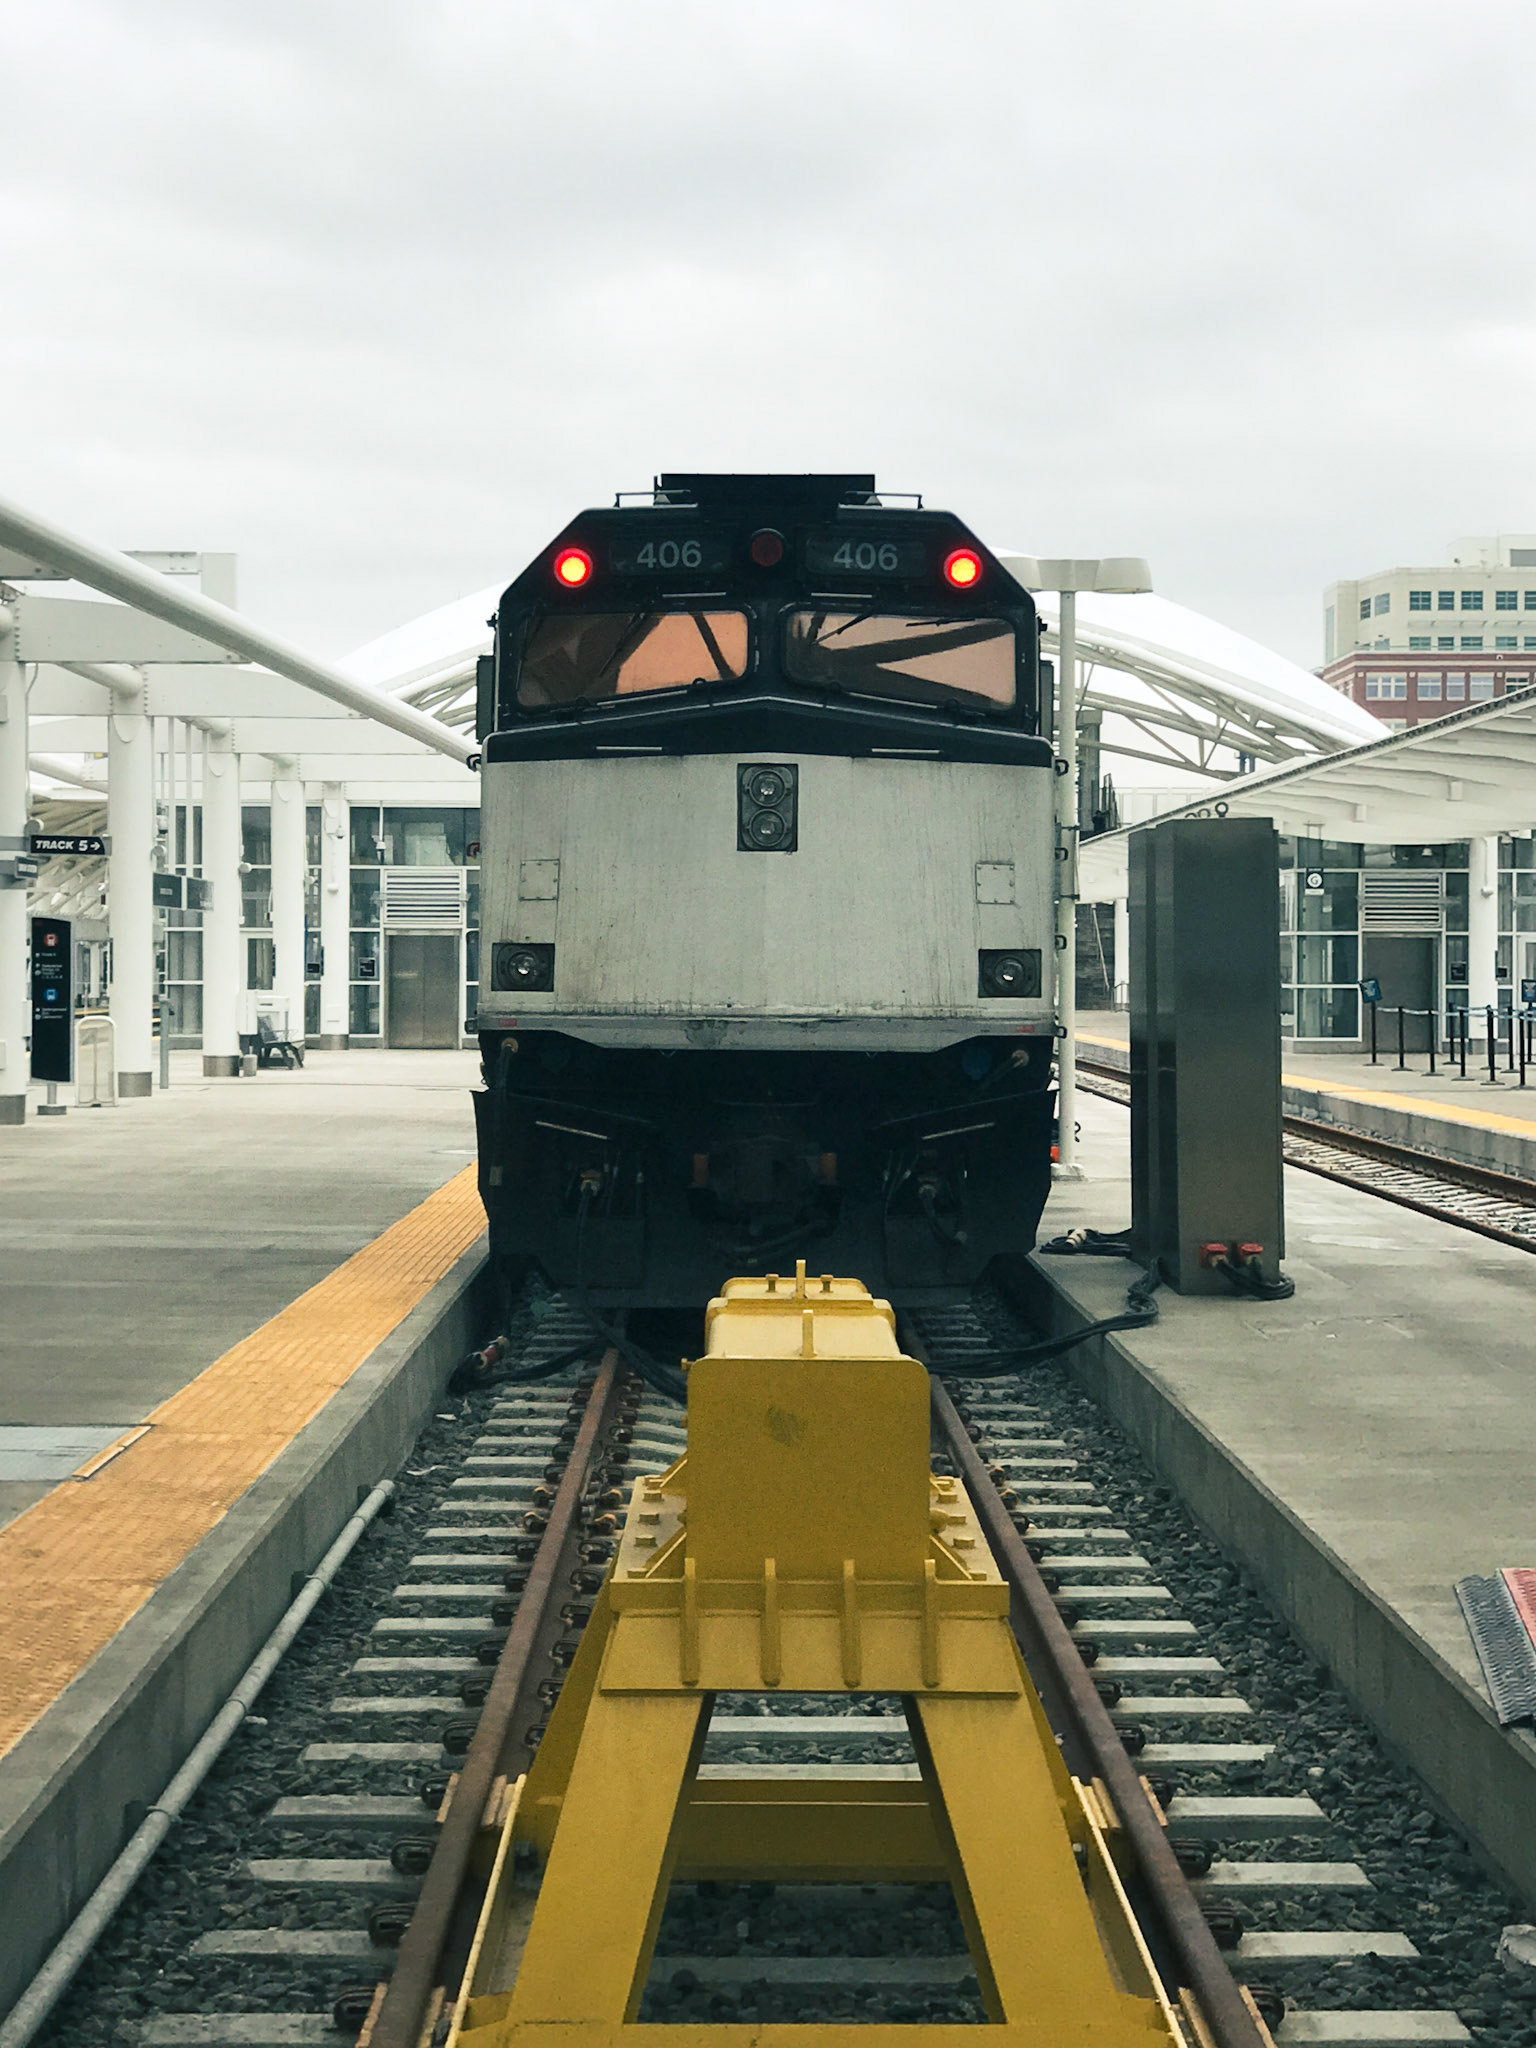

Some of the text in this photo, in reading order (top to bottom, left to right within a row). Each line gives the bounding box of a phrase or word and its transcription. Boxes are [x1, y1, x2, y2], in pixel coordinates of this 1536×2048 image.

[636, 540, 702, 568] 406
[833, 541, 898, 571] 406
[36, 840, 88, 852] TRACK 5
